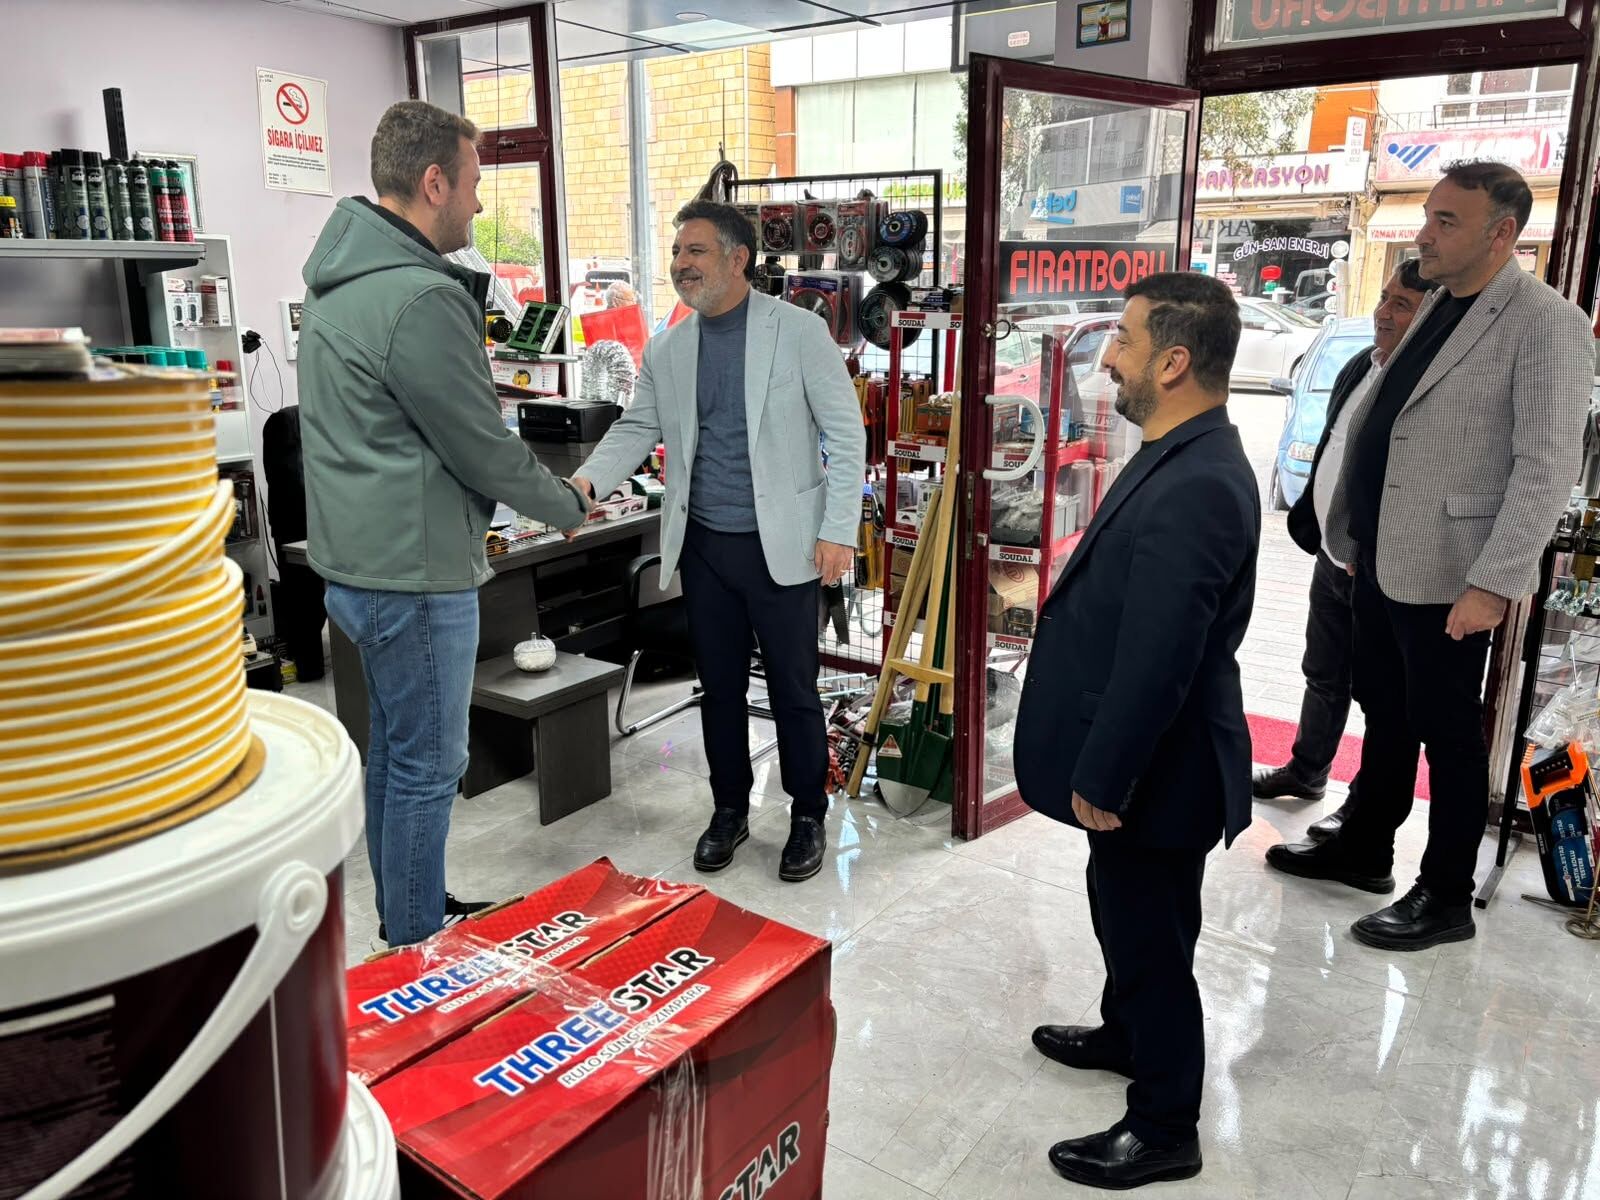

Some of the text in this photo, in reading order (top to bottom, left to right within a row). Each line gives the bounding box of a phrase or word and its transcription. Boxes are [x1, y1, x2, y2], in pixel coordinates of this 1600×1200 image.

[267, 125, 324, 154] SİGARA İÇİLMEZ
[1371, 228, 1397, 239] YAMAN
[1233, 237, 1330, 261] GÜN-SAN ENERJİ
[898, 319, 926, 328] SOUDAL
[893, 449, 920, 459] SOUDAL
[999, 552, 1034, 563] SOUDAL
[995, 641, 1029, 652] SOUDAL
[497, 911, 595, 958] STAR
[475, 948, 714, 1096] THREE STAR
[561, 1050, 602, 1085] RULO
[656, 984, 709, 1024] ZIMPARA
